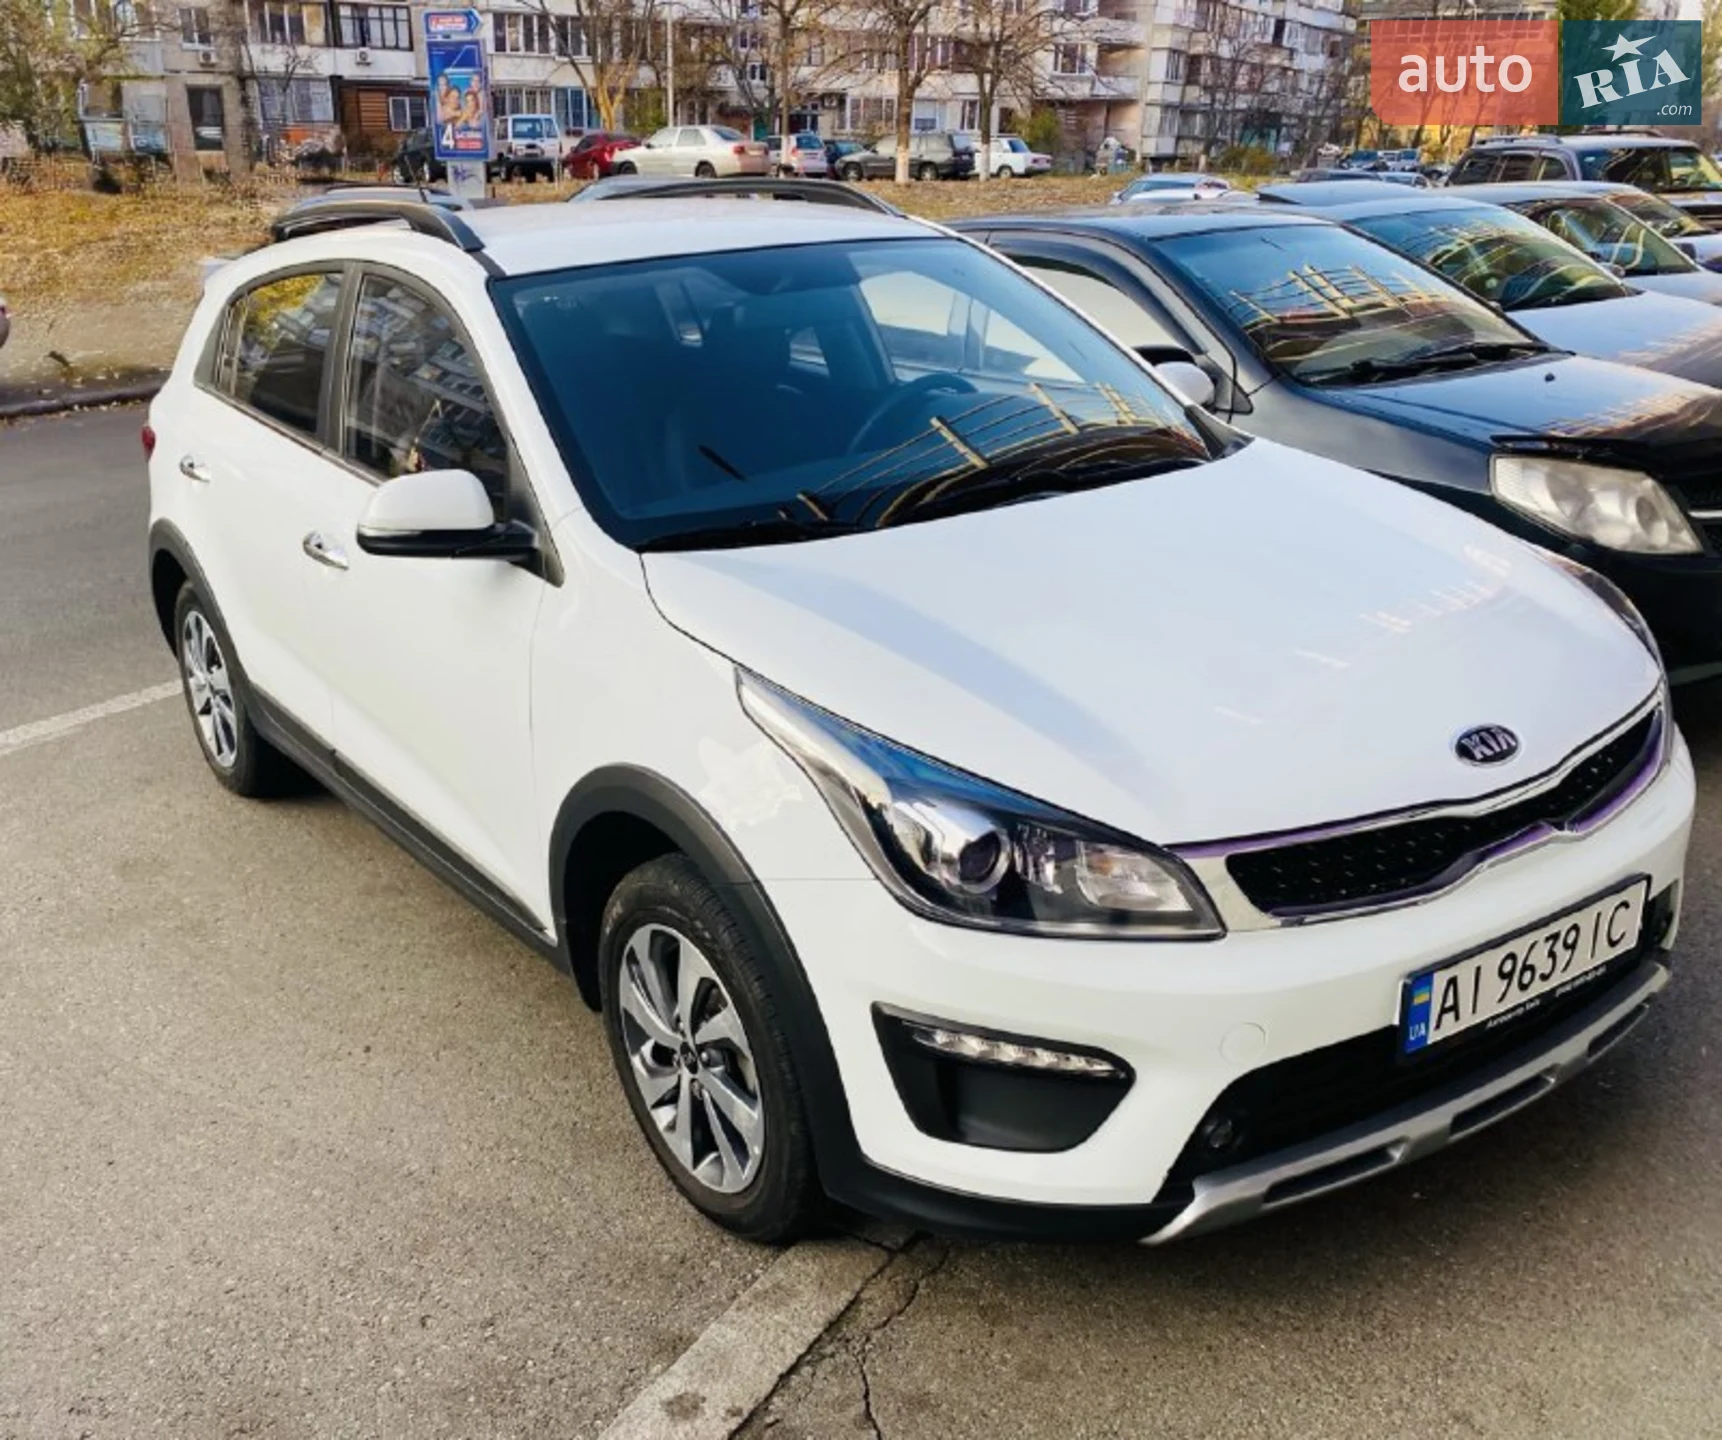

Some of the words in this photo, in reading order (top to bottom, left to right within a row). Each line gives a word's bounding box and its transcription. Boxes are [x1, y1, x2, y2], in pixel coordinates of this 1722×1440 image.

[441, 122, 455, 149] 4
[1460, 726, 1517, 760] KIA
[1434, 965, 1481, 1031] AI
[1497, 923, 1580, 1003] 9639
[1590, 900, 1630, 959] IC
[1408, 1022, 1426, 1041] UA
